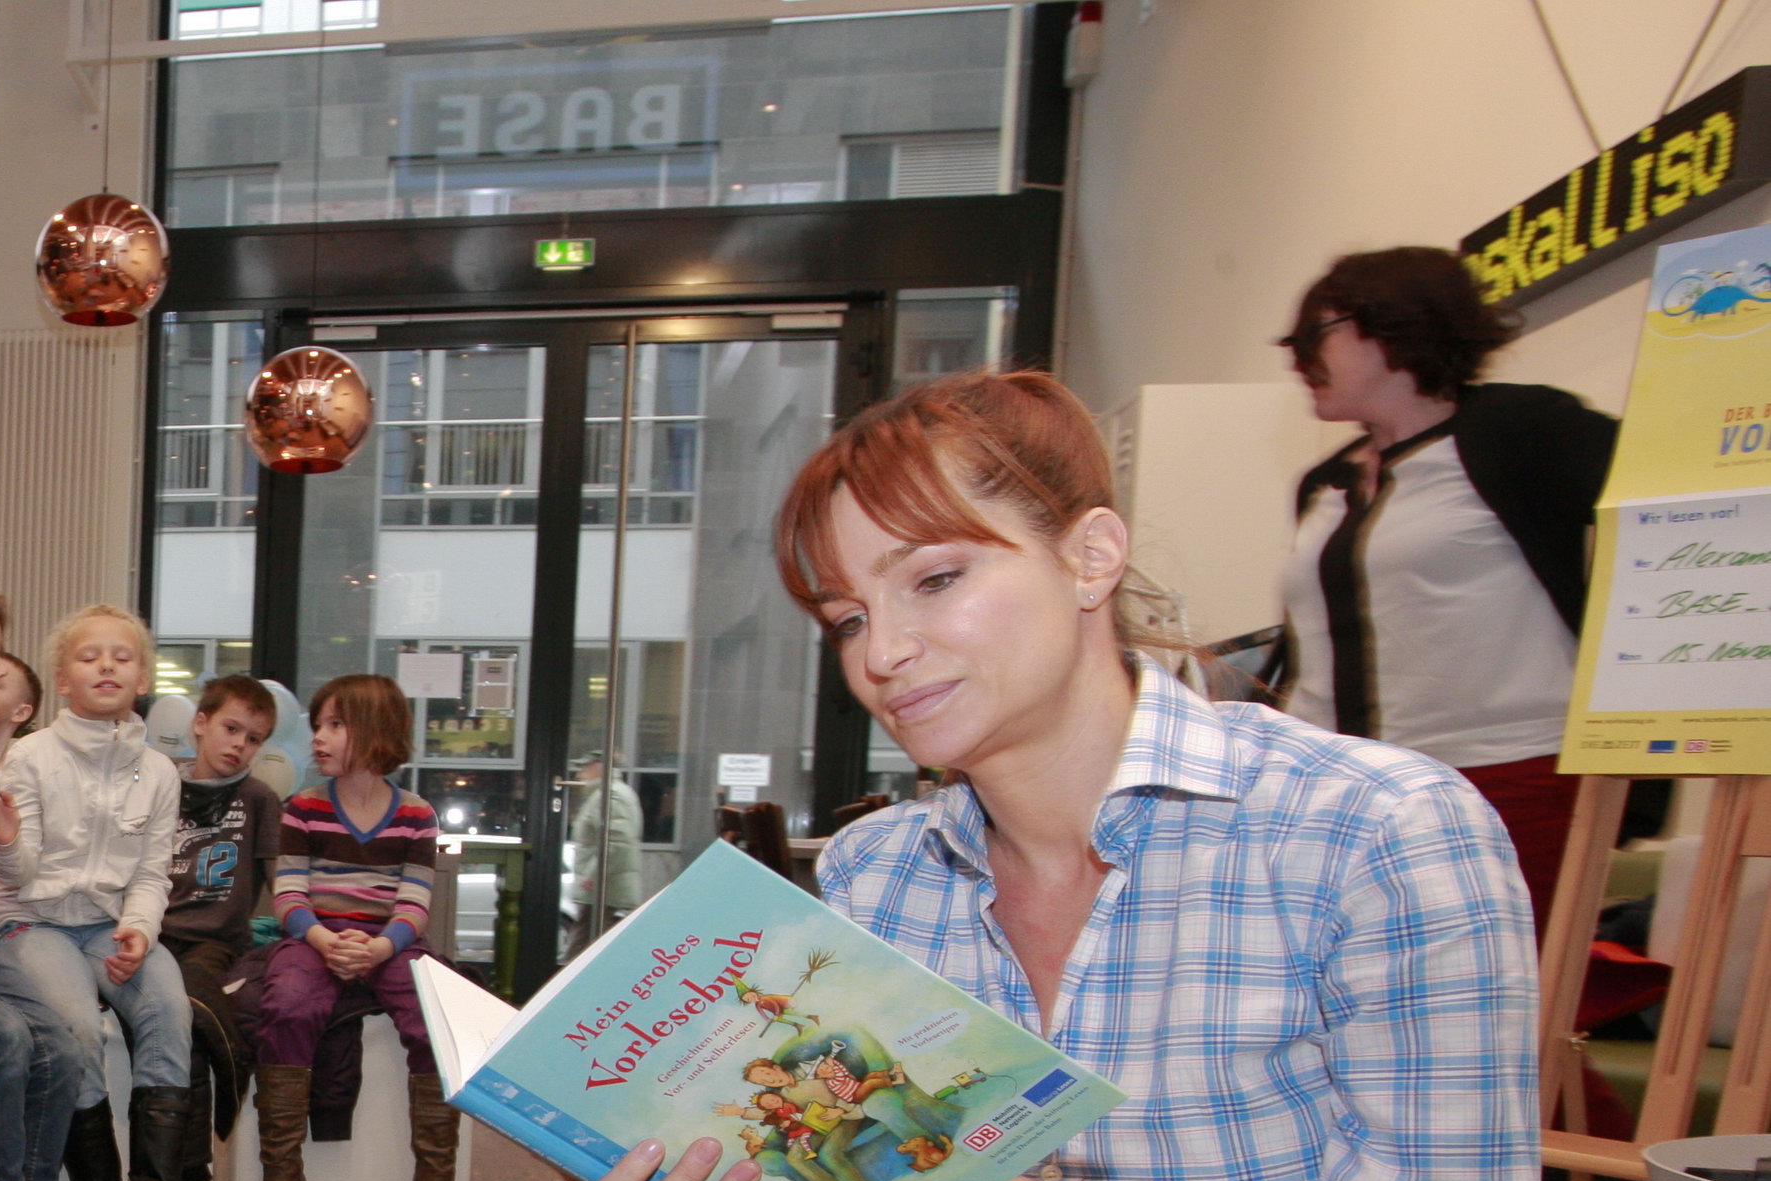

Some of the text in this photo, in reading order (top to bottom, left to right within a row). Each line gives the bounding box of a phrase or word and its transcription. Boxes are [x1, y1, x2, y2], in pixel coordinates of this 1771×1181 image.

[1724, 406, 1756, 423] DER
[1719, 424, 1771, 456] VO
[1638, 504, 1740, 524] Wir lesen vor!
[196, 841, 238, 888] 12
[563, 934, 701, 1051] Mein großes
[585, 929, 764, 1090] Vorlesebuch
[897, 1011, 959, 1047] Mit praktischen
[910, 1023, 960, 1049] Vorlesetipps
[657, 1018, 734, 1083] Geschichten zum
[663, 1020, 757, 1098] Vor- und Selberlesen
[992, 1104, 1018, 1122] Mobility
[999, 1105, 1028, 1126] Networks
[1005, 1111, 1032, 1130] Logistics
[967, 1126, 999, 1149] DB
